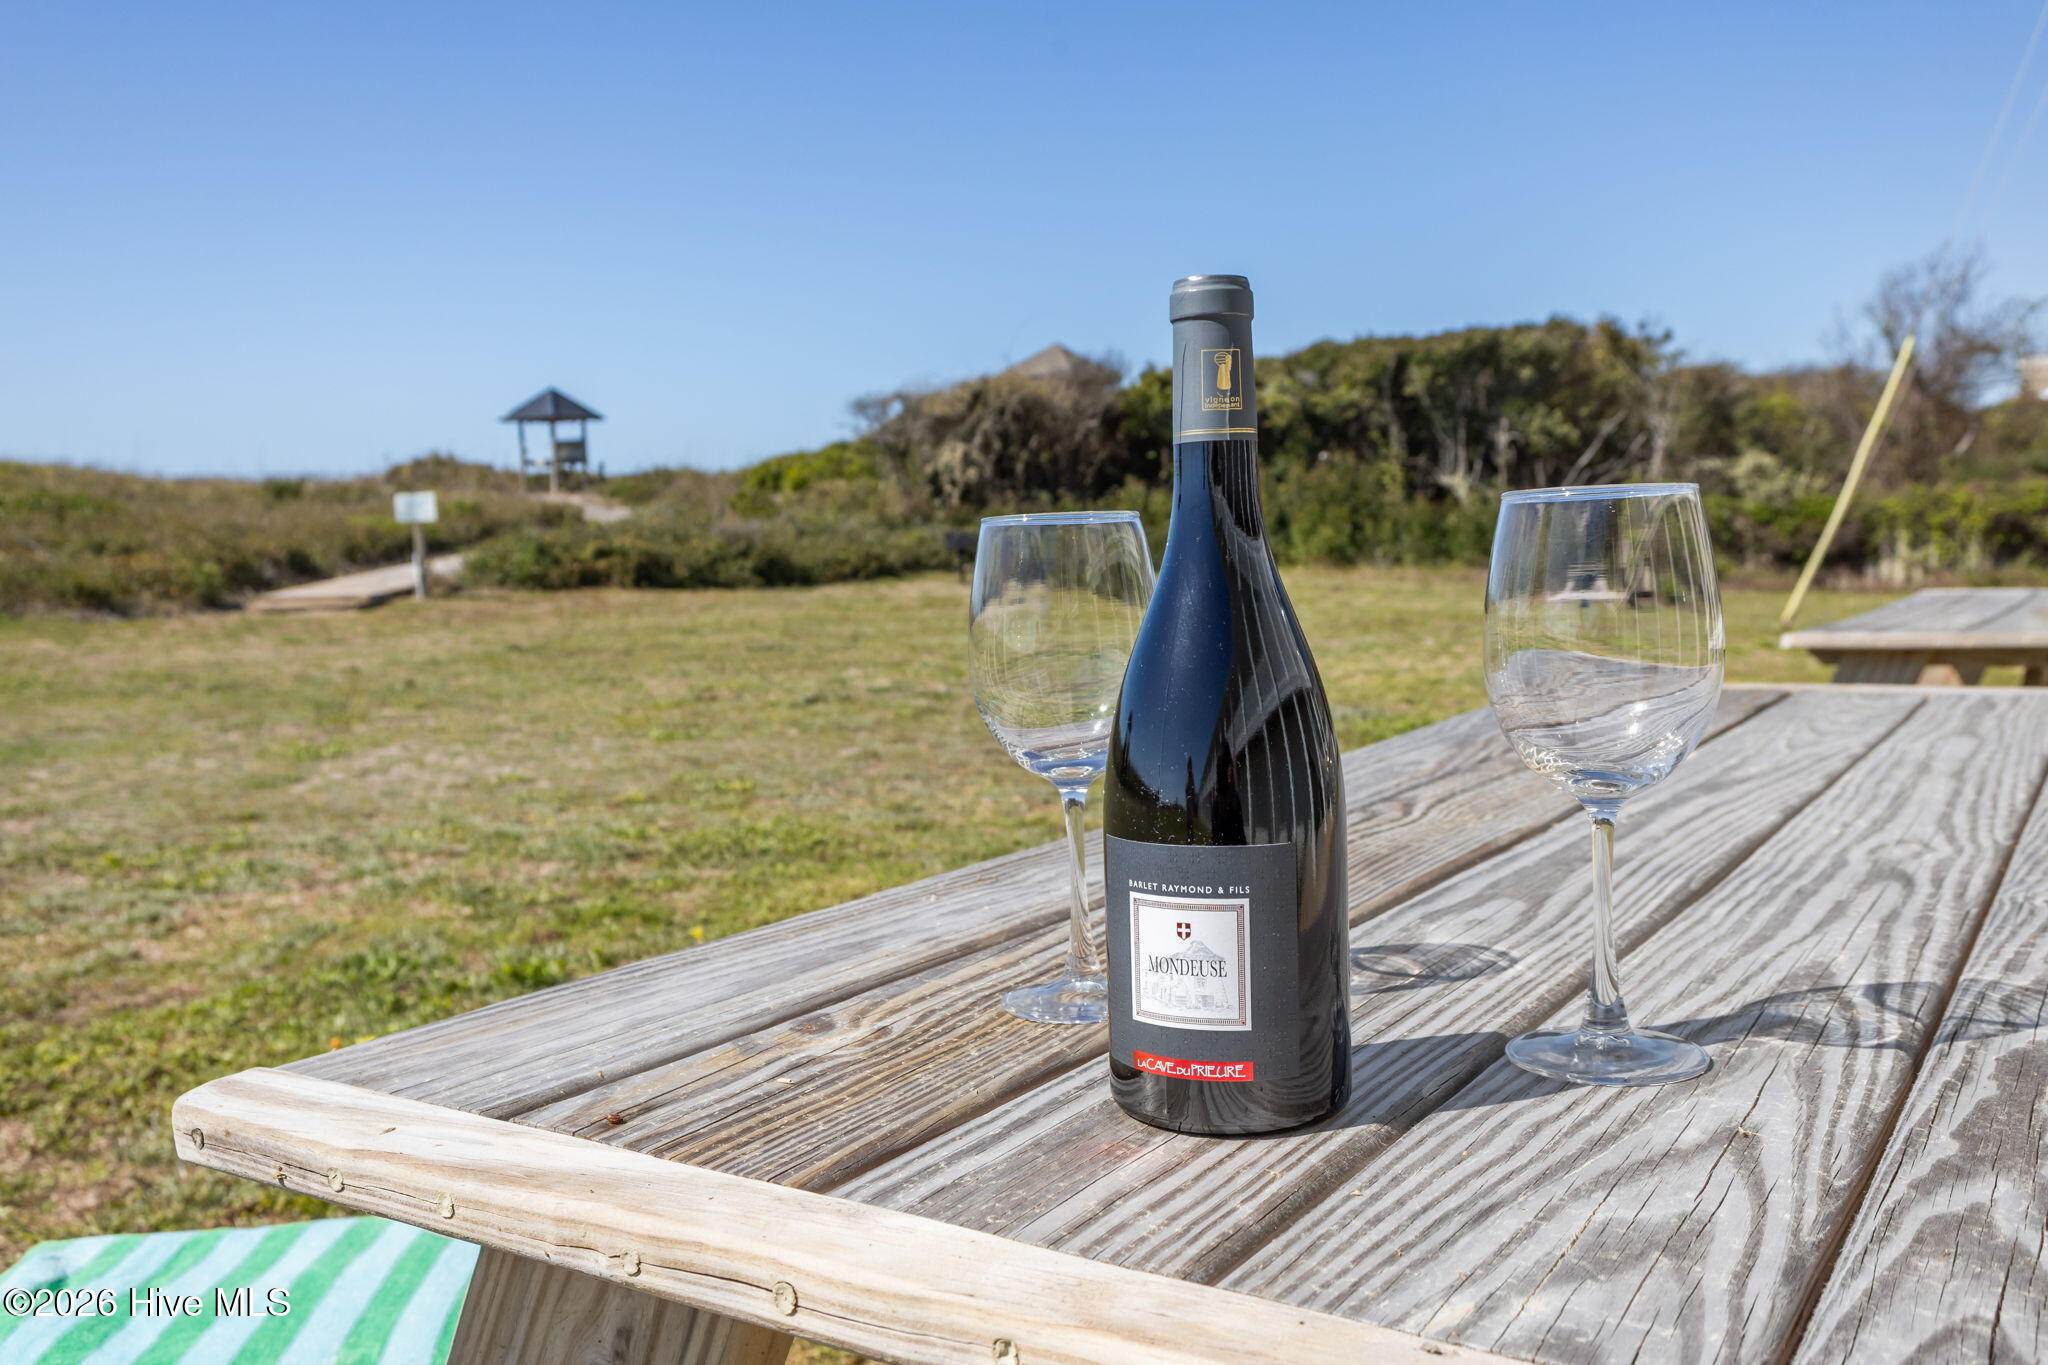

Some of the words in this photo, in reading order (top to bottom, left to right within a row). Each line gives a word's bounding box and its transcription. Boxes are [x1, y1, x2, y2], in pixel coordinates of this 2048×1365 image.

[1129, 879, 1158, 891] BARLET
[1162, 884, 1212, 894] RAYMOND
[1217, 886, 1224, 894] &
[1229, 886, 1250, 894] FILS
[1148, 955, 1227, 977] MONDEUSE
